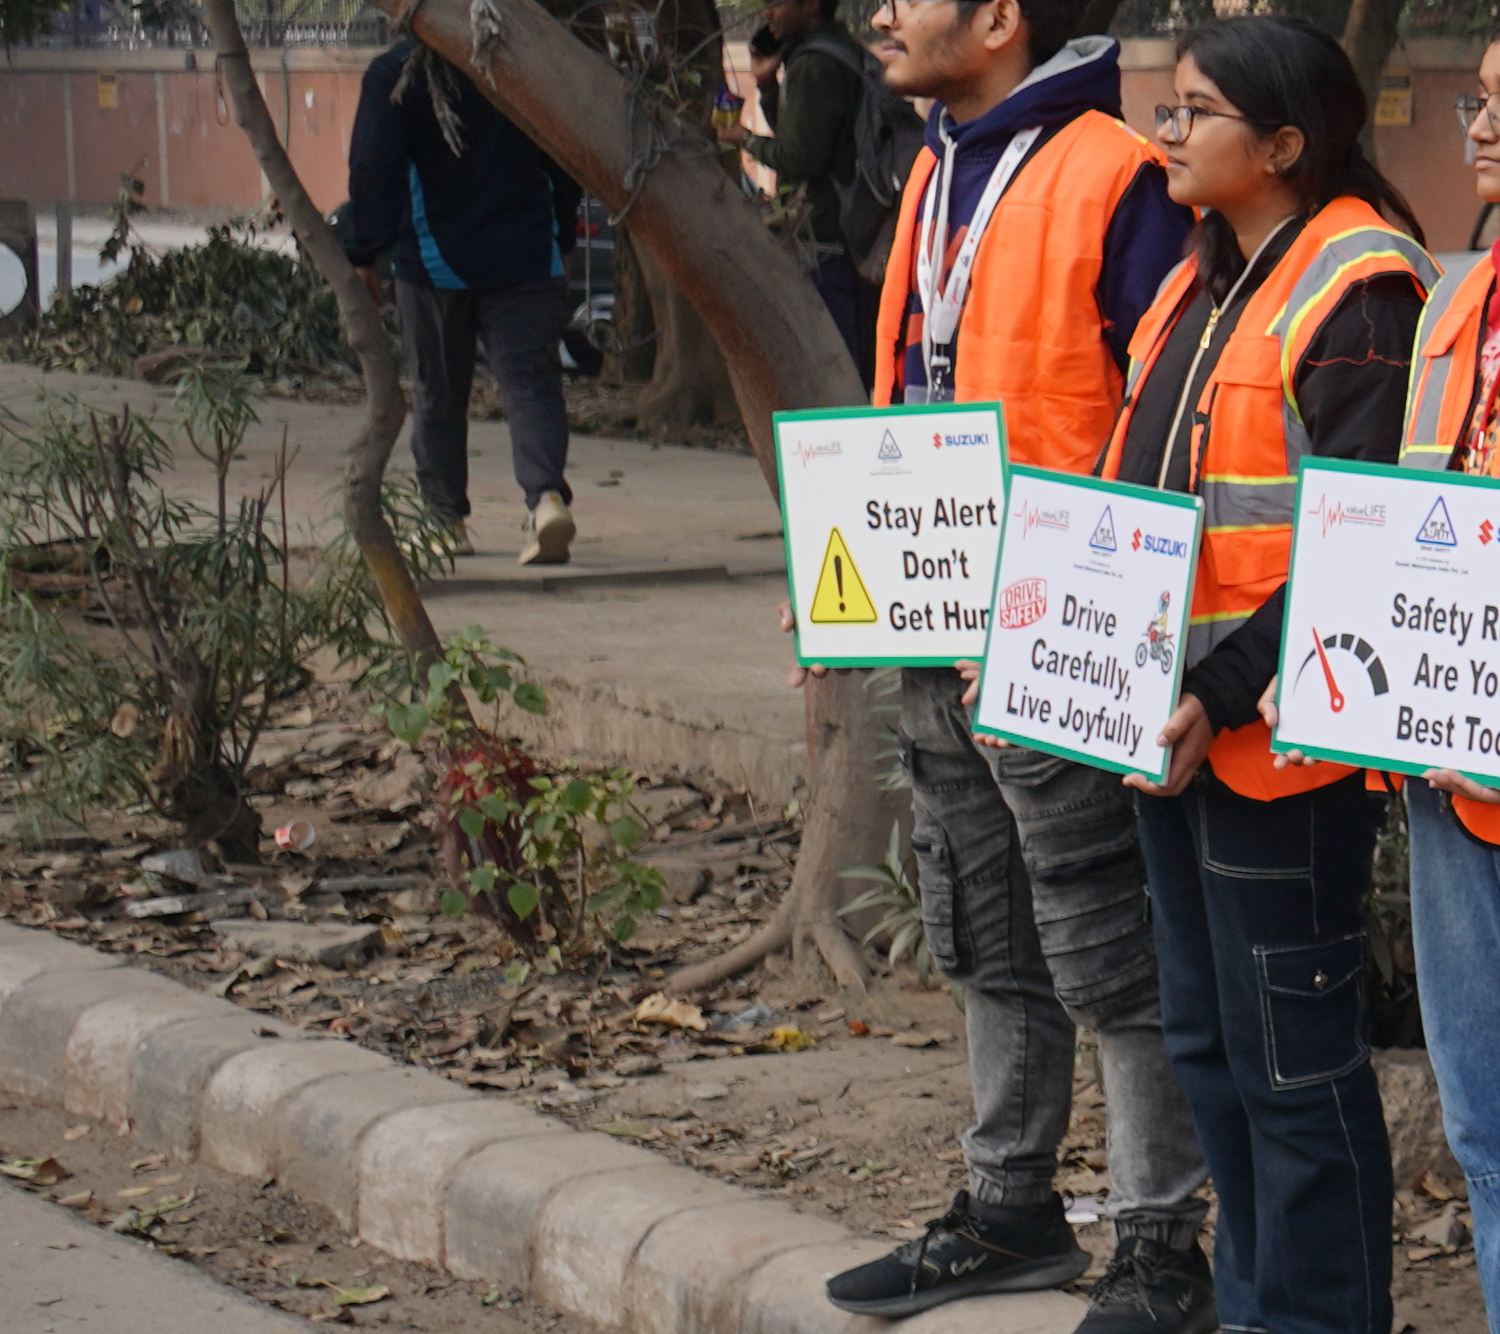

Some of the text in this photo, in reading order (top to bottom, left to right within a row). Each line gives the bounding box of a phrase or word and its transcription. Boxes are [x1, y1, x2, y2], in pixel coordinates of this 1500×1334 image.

[945, 433, 989, 447] SUZUKI
[866, 496, 997, 537] Stay Alert
[1143, 534, 1187, 558] SUZUKI
[1001, 598, 1046, 627] SAFELY
[1005, 582, 1042, 608] DRIVE
[1062, 594, 1117, 636] Drive
[889, 601, 990, 632] Get Hur
[1391, 592, 1474, 646] Safety
[1031, 638, 1132, 701] Carefully,
[1413, 652, 1459, 692] Are
[1006, 682, 1143, 756] Live Joyfully
[1397, 705, 1455, 748] Best
